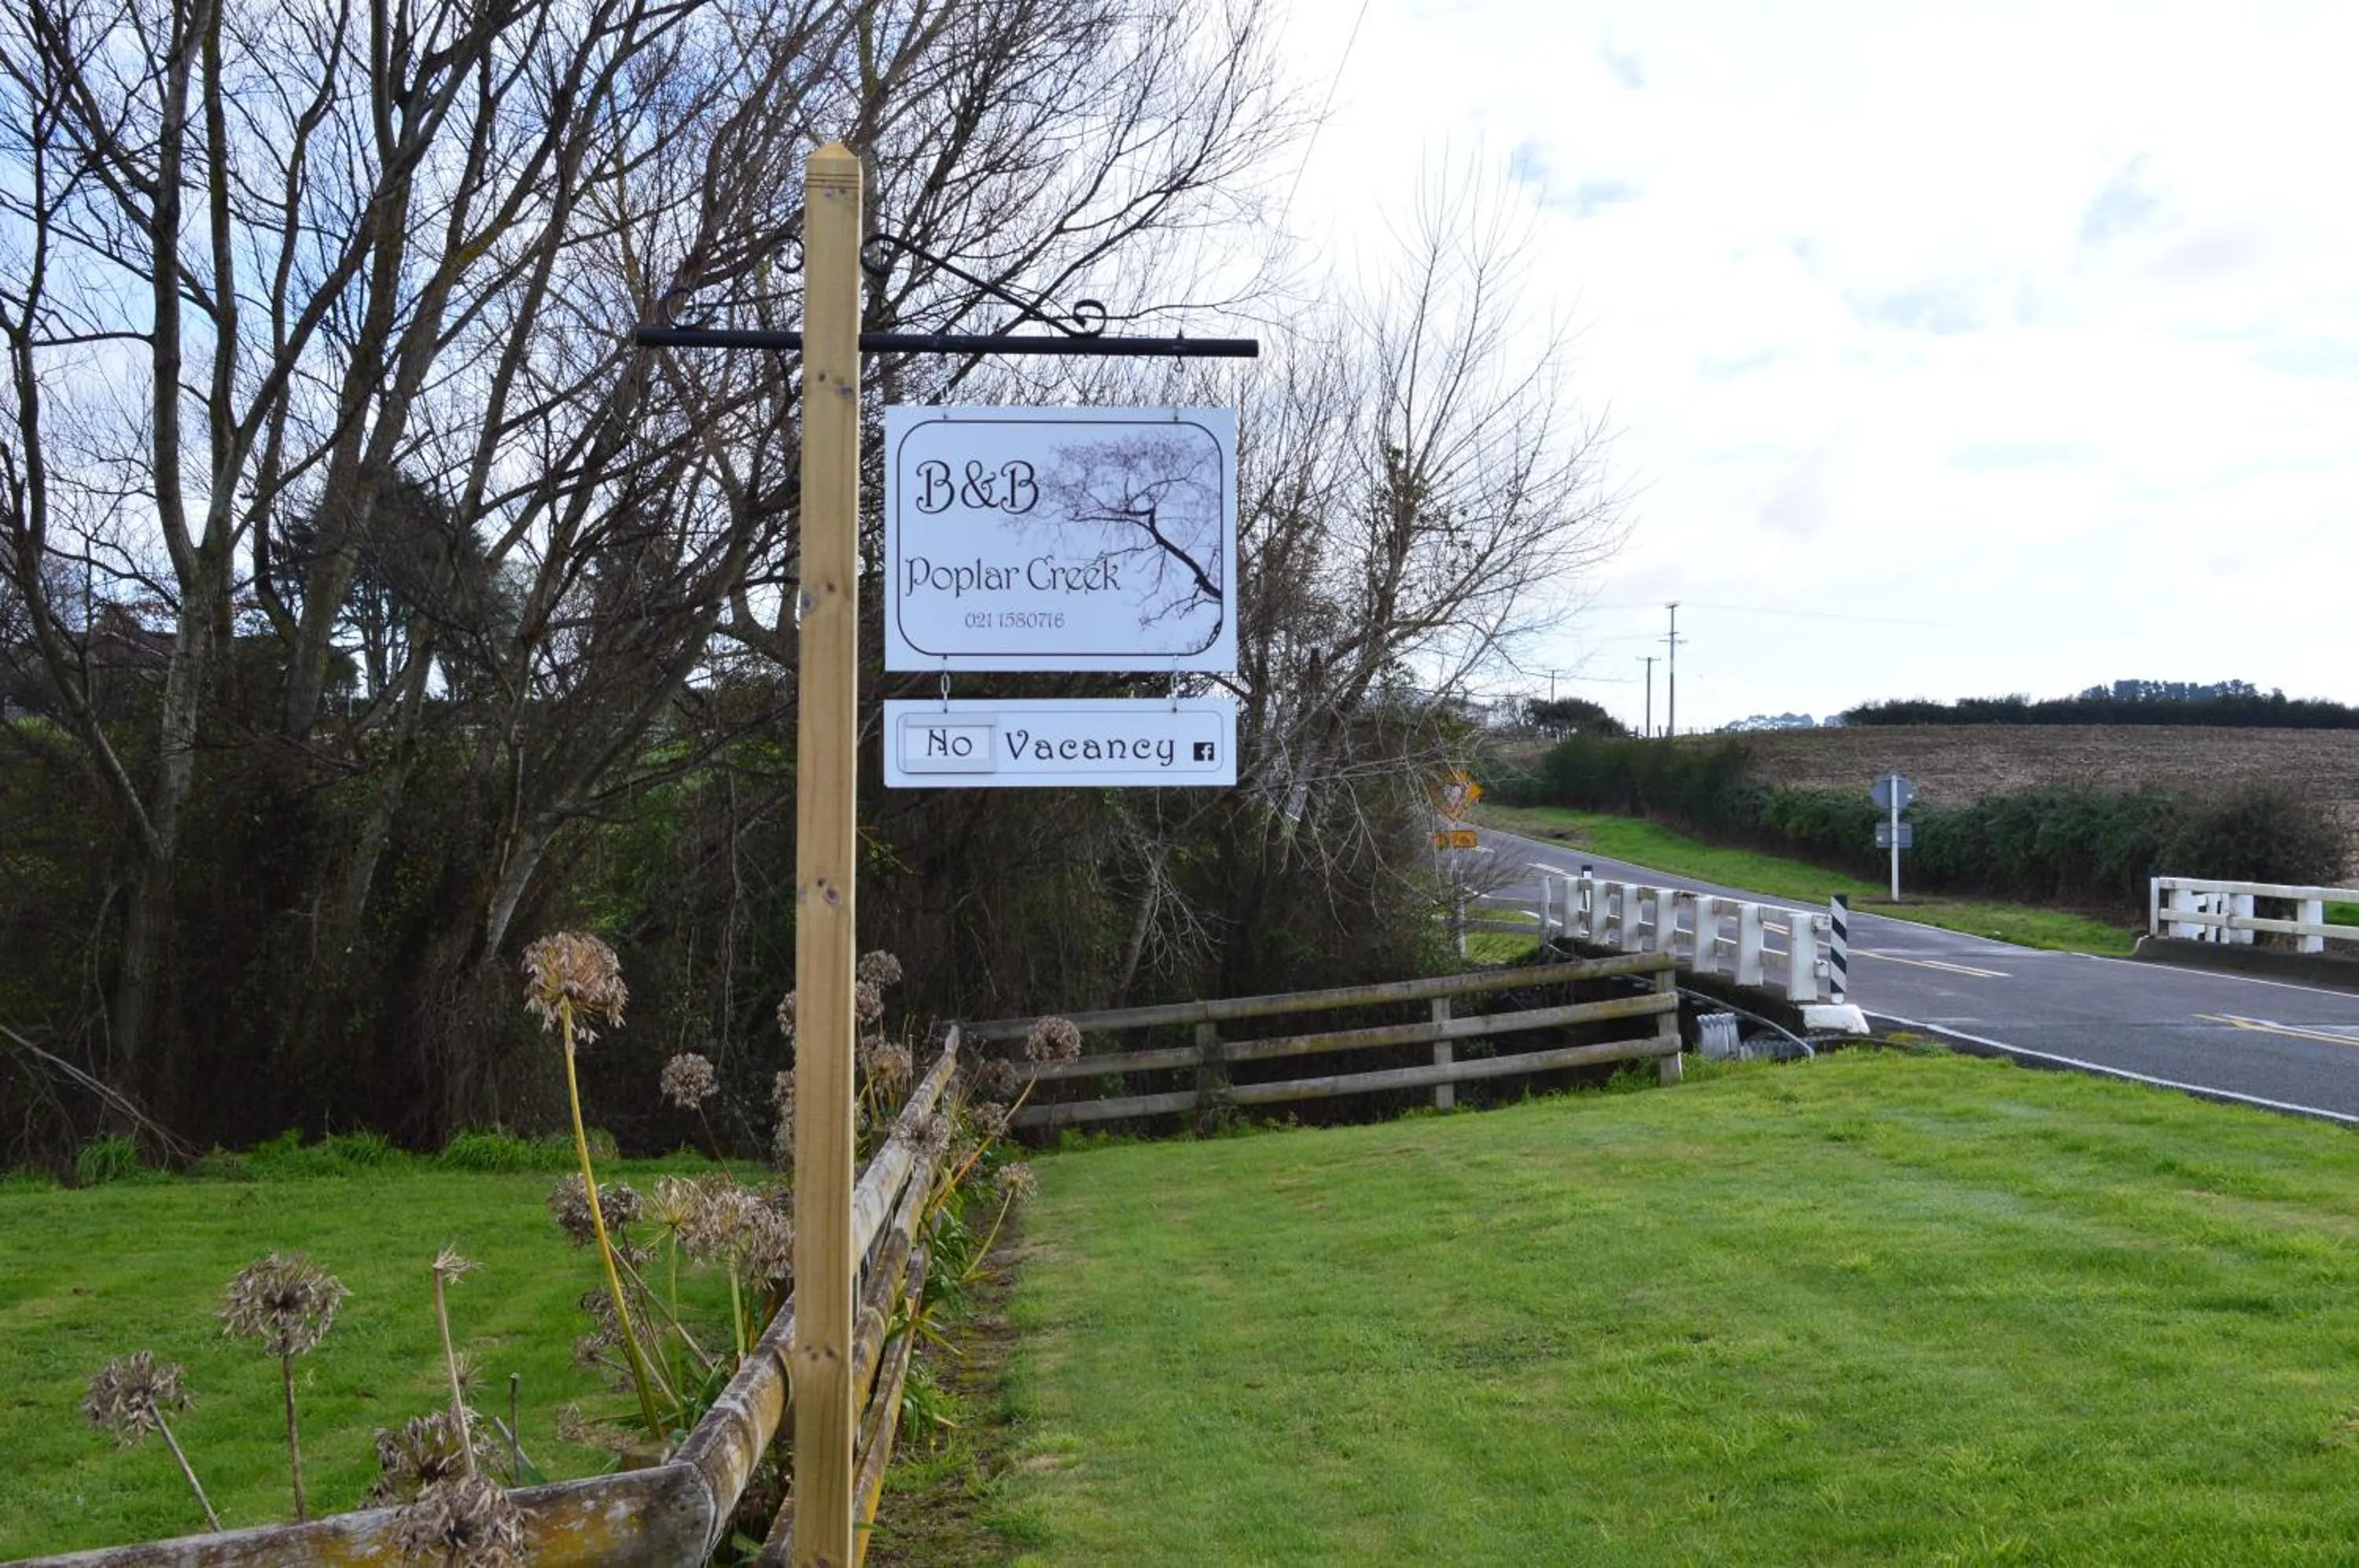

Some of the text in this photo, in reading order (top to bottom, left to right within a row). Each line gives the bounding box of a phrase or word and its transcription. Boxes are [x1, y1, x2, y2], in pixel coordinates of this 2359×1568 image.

[915, 459, 1040, 515] B&B
[905, 554, 1121, 598] Poplar Creek
[964, 613, 992, 628] 021
[926, 729, 1176, 767] No Vacancy
